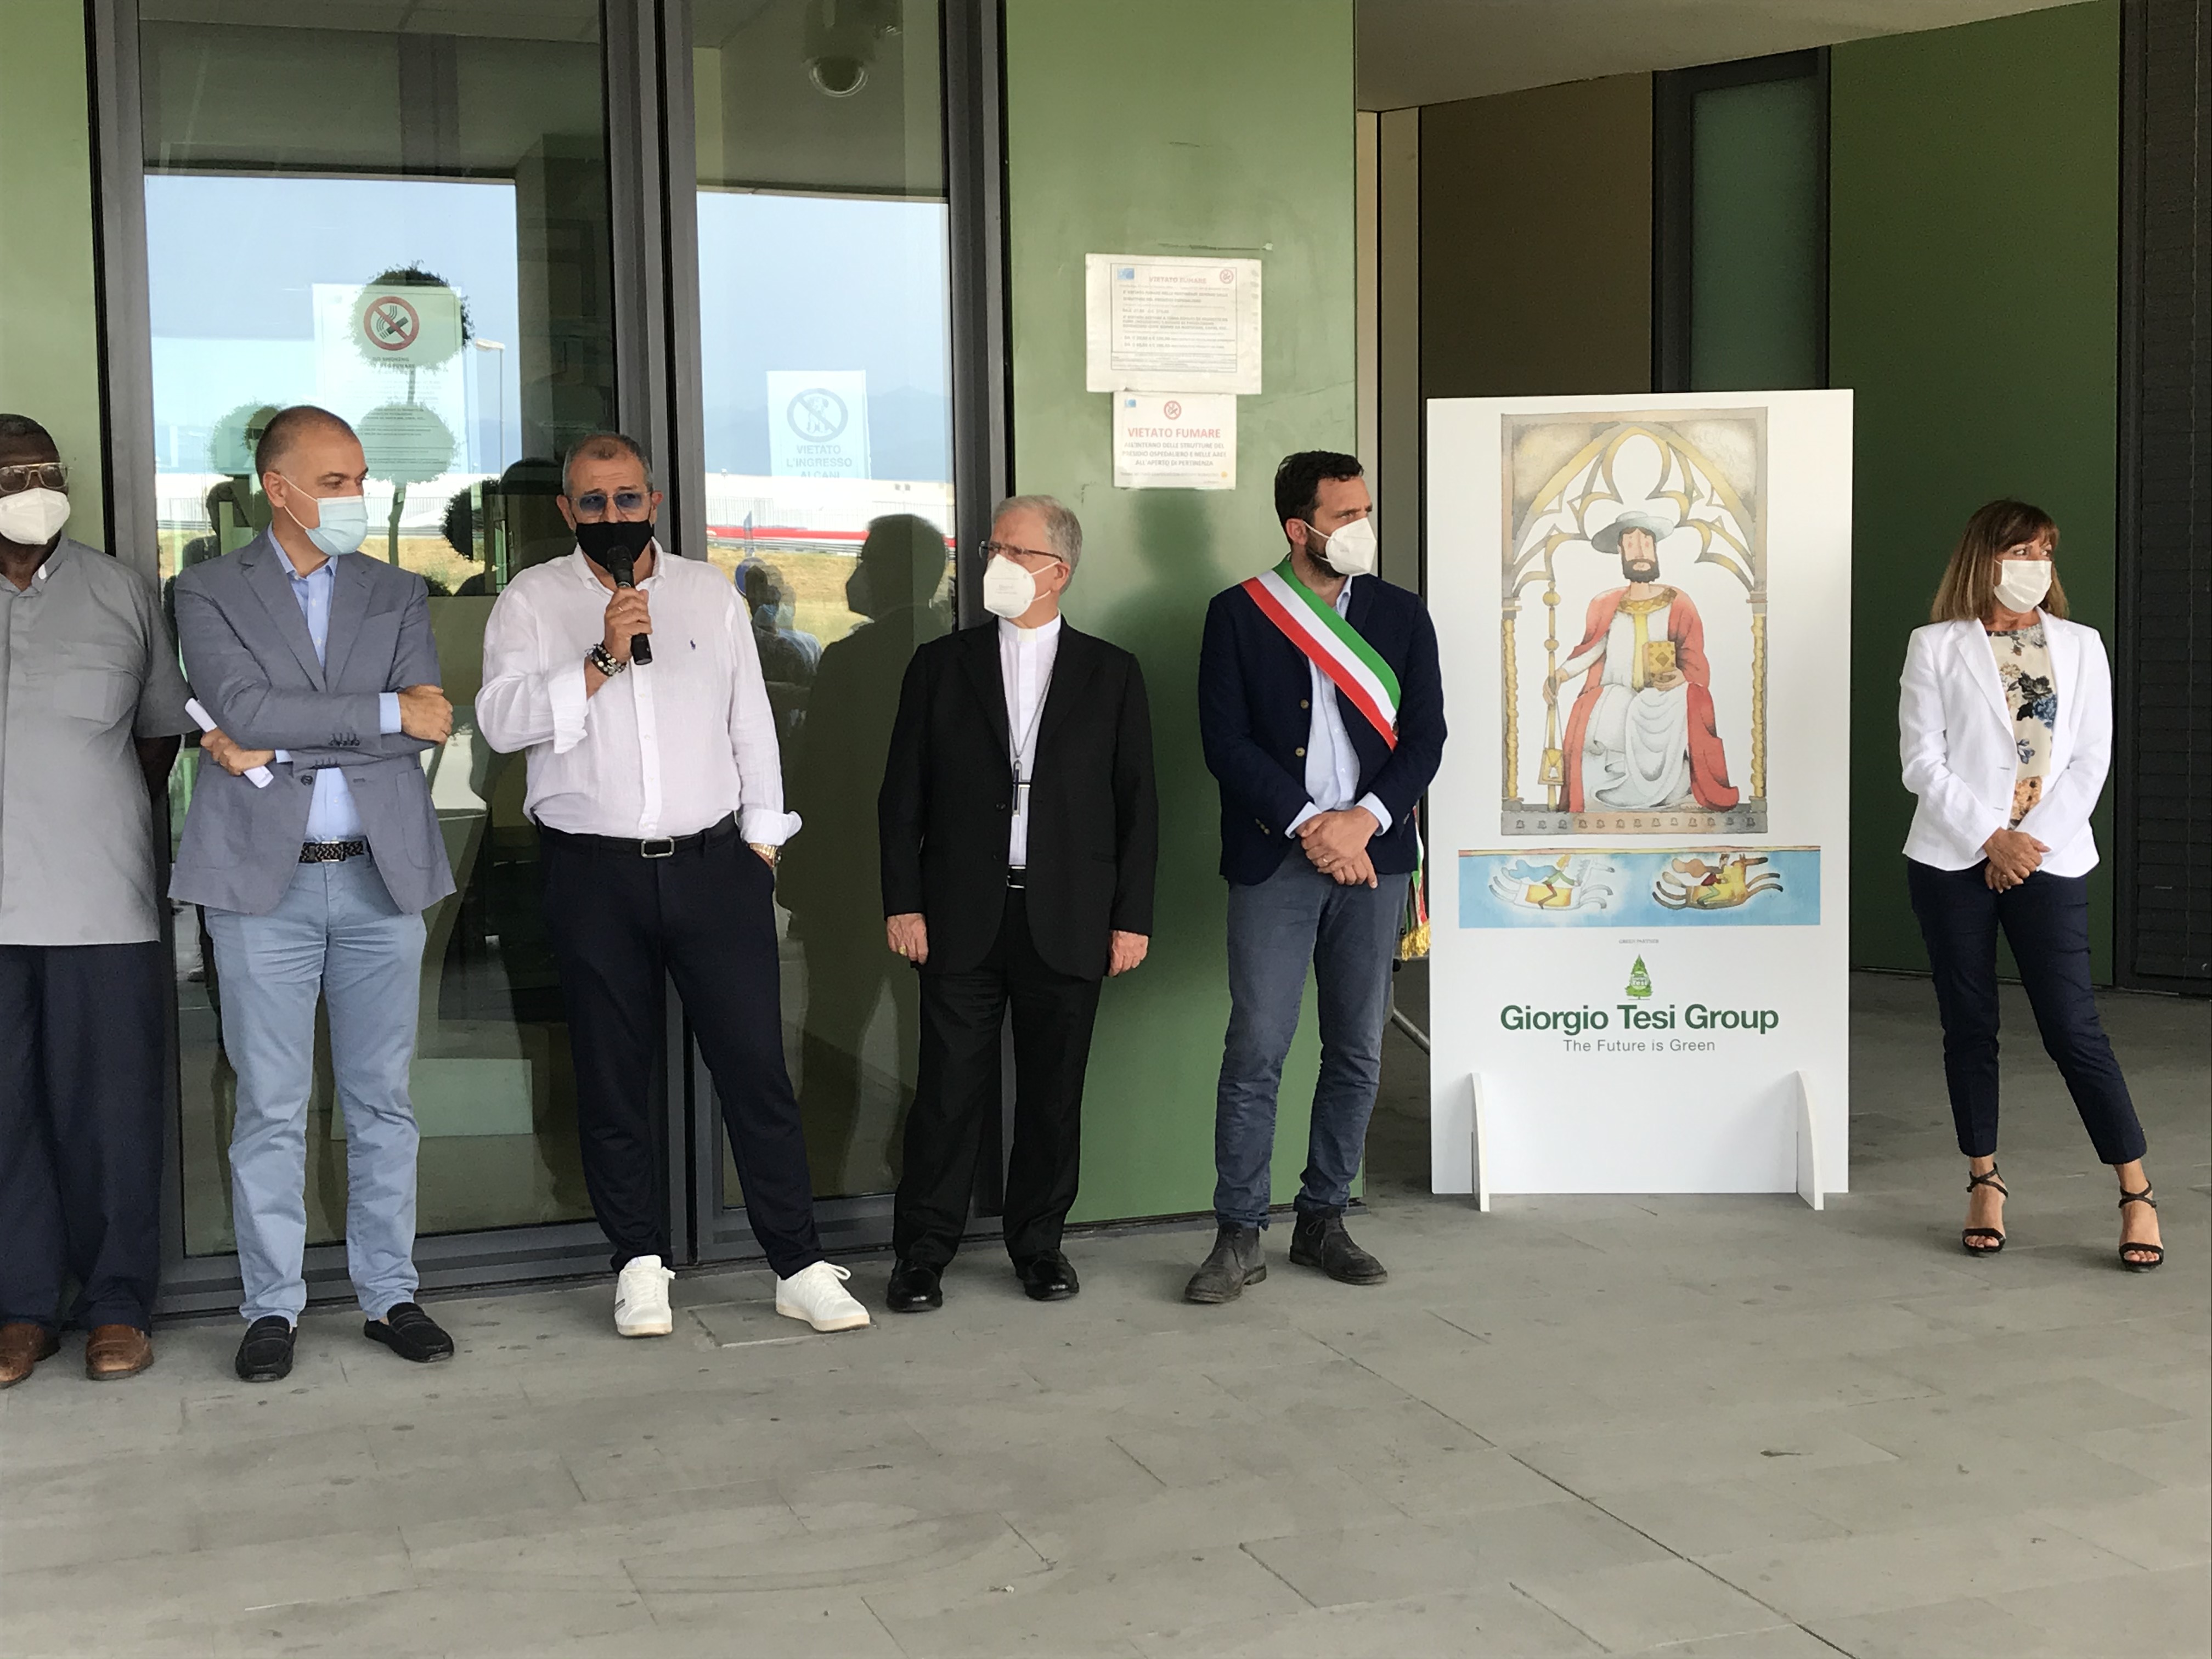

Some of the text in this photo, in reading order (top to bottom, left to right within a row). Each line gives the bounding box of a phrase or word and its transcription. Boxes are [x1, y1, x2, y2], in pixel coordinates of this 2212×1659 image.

[1128, 427, 1221, 438] VIETATO FUMARE
[797, 445, 841, 454] VIETATO
[786, 458, 853, 467] L'INGRESSO
[1500, 1003, 1780, 1035] Giorgio Tesi Group
[1564, 1039, 1716, 1052] The Future is Green
